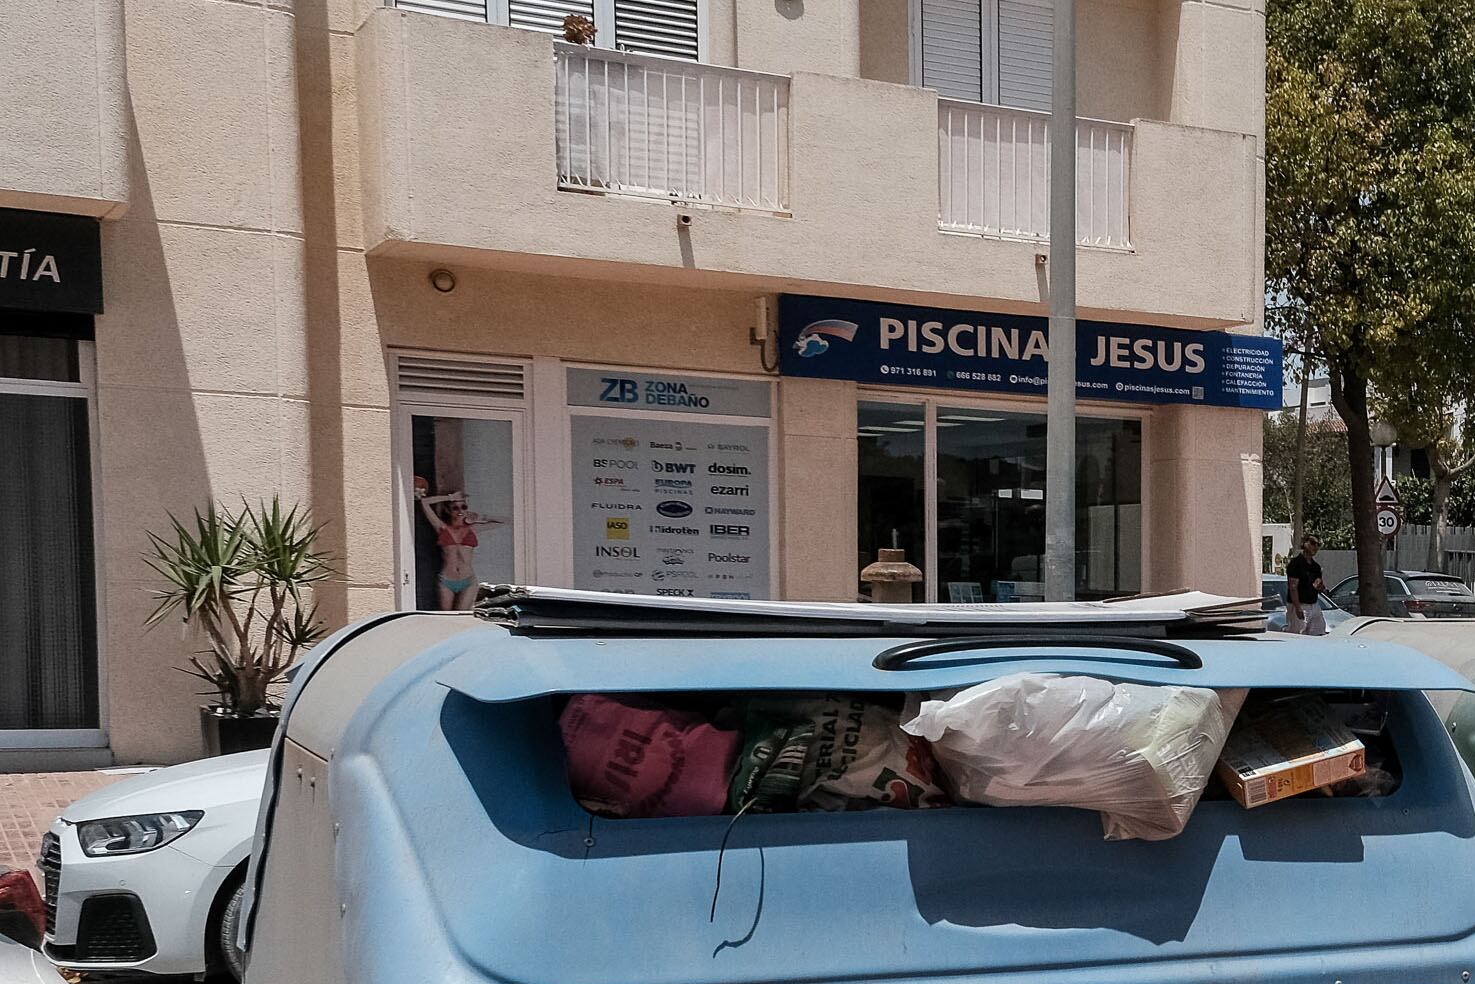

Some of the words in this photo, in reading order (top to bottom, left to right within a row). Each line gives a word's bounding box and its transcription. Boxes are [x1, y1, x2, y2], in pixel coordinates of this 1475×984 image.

[879, 317, 1050, 362] PISCINA
[1090, 335, 1206, 374] JESUS
[1226, 348, 1270, 356] ELECTRICIDAD
[1226, 355, 1274, 365] CONSTRUCCIÓN
[1226, 364, 1265, 372] DEPURACIÓN
[645, 380, 689, 395] ZONA
[1225, 379, 1267, 388] CALEFACCIÓN
[600, 378, 639, 403] ZB
[1124, 383, 1190, 395] piscinasjesus.com
[1225, 386, 1275, 396] MANTENIMIENTO
[645, 392, 710, 409] DEBAÑO
[666, 464, 696, 474] BWT
[710, 485, 749, 497] ezarri
[592, 503, 642, 511] FLUIDRA
[607, 522, 628, 530] IASO
[1379, 517, 1394, 527] 30
[710, 525, 750, 536] IBER
[708, 552, 750, 563] Poolstar
